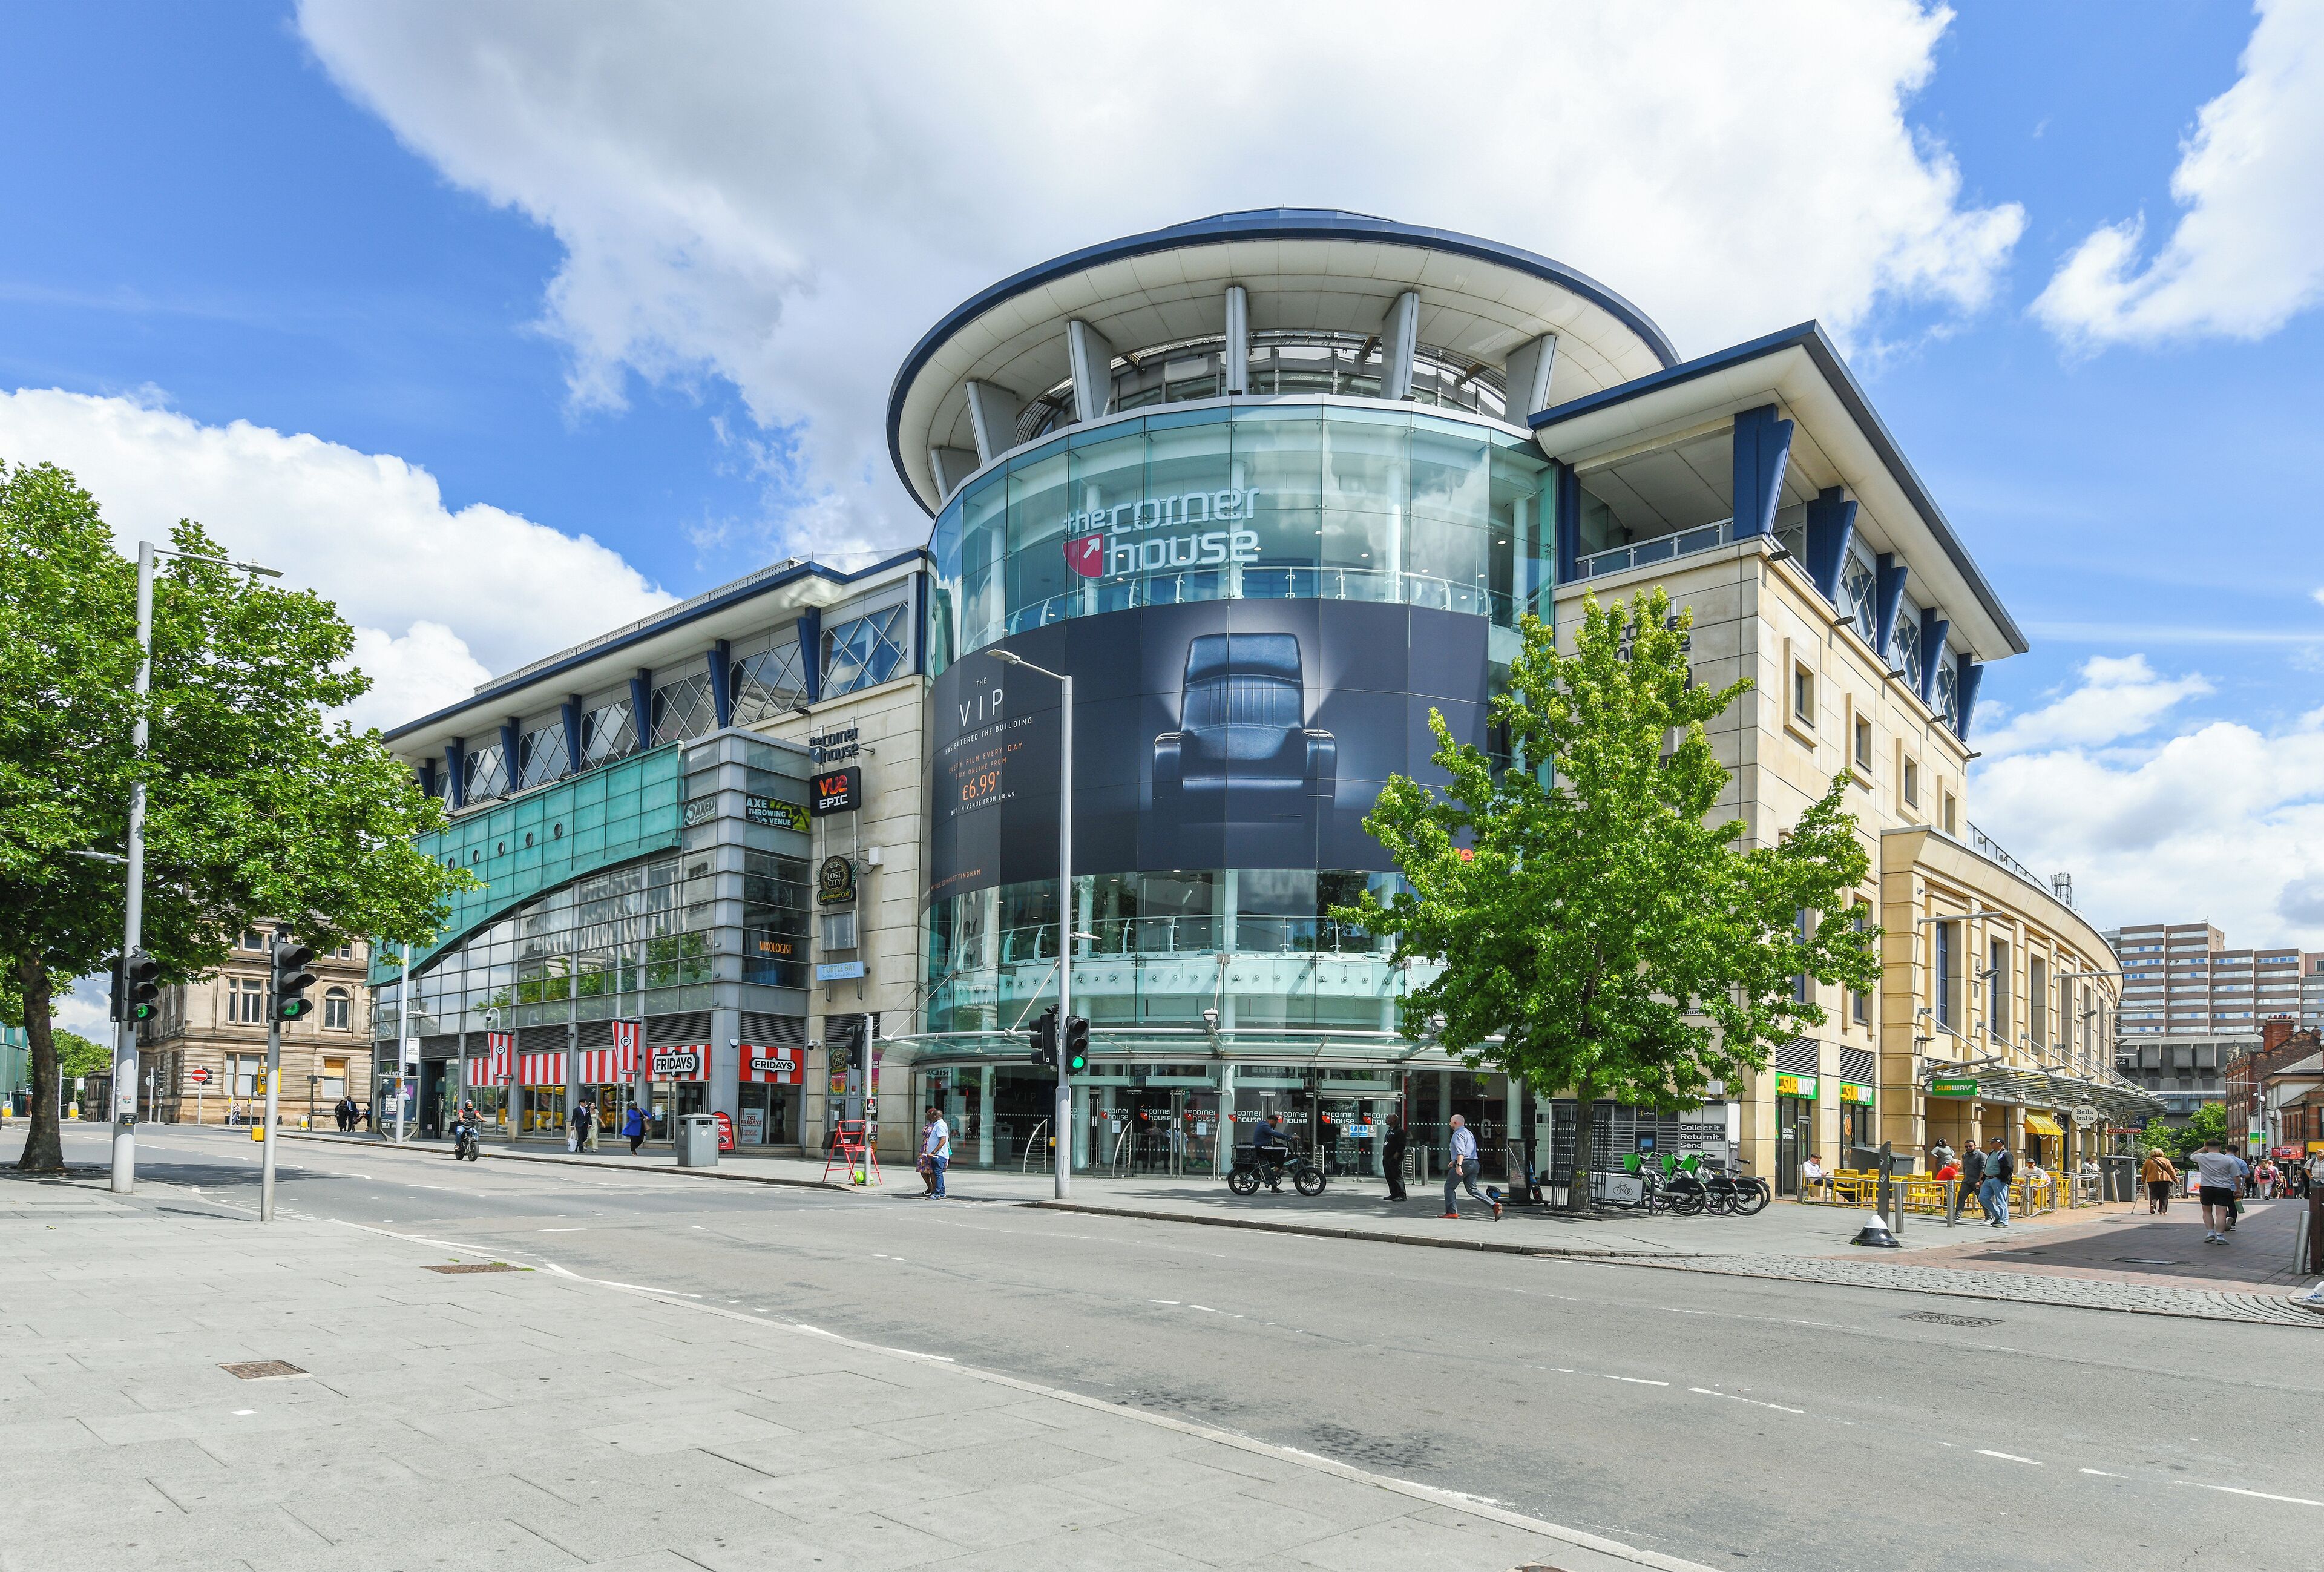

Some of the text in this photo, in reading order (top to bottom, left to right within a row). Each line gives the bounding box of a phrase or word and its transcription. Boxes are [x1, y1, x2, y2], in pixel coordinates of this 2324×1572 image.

[1064, 488, 1260, 535] the corner
[1110, 530, 1259, 576] house
[976, 677, 987, 688] THE
[959, 688, 1003, 727] VIP
[809, 727, 859, 747] the corner
[954, 733, 979, 749] ENTERED
[981, 728, 993, 738] THE
[996, 717, 1032, 733] BUILDING
[822, 743, 859, 763] house
[949, 742, 1023, 774] EVERY FILM EVERY DAY
[955, 757, 1007, 780] BUY ONLINE FROM
[746, 798, 767, 809] AXE
[819, 794, 849, 809] EPIC
[966, 800, 981, 810] VENUE
[983, 795, 996, 804] FROM
[998, 791, 1016, 801] £8.49
[748, 808, 786, 817] THROWING
[769, 817, 792, 826] VENUE
[827, 871, 841, 880] LOST
[827, 878, 841, 887] CITY
[759, 941, 792, 955] MIXOLOGIST
[822, 963, 856, 973] TURTLE BAY
[655, 1057, 692, 1070] FRIDAYS
[755, 1060, 793, 1070] FRIDAYS
[1777, 1075, 1816, 1095] SUBWAY
[1014, 1091, 1037, 1102] VIP
[1840, 1085, 1873, 1102] SUBWAY
